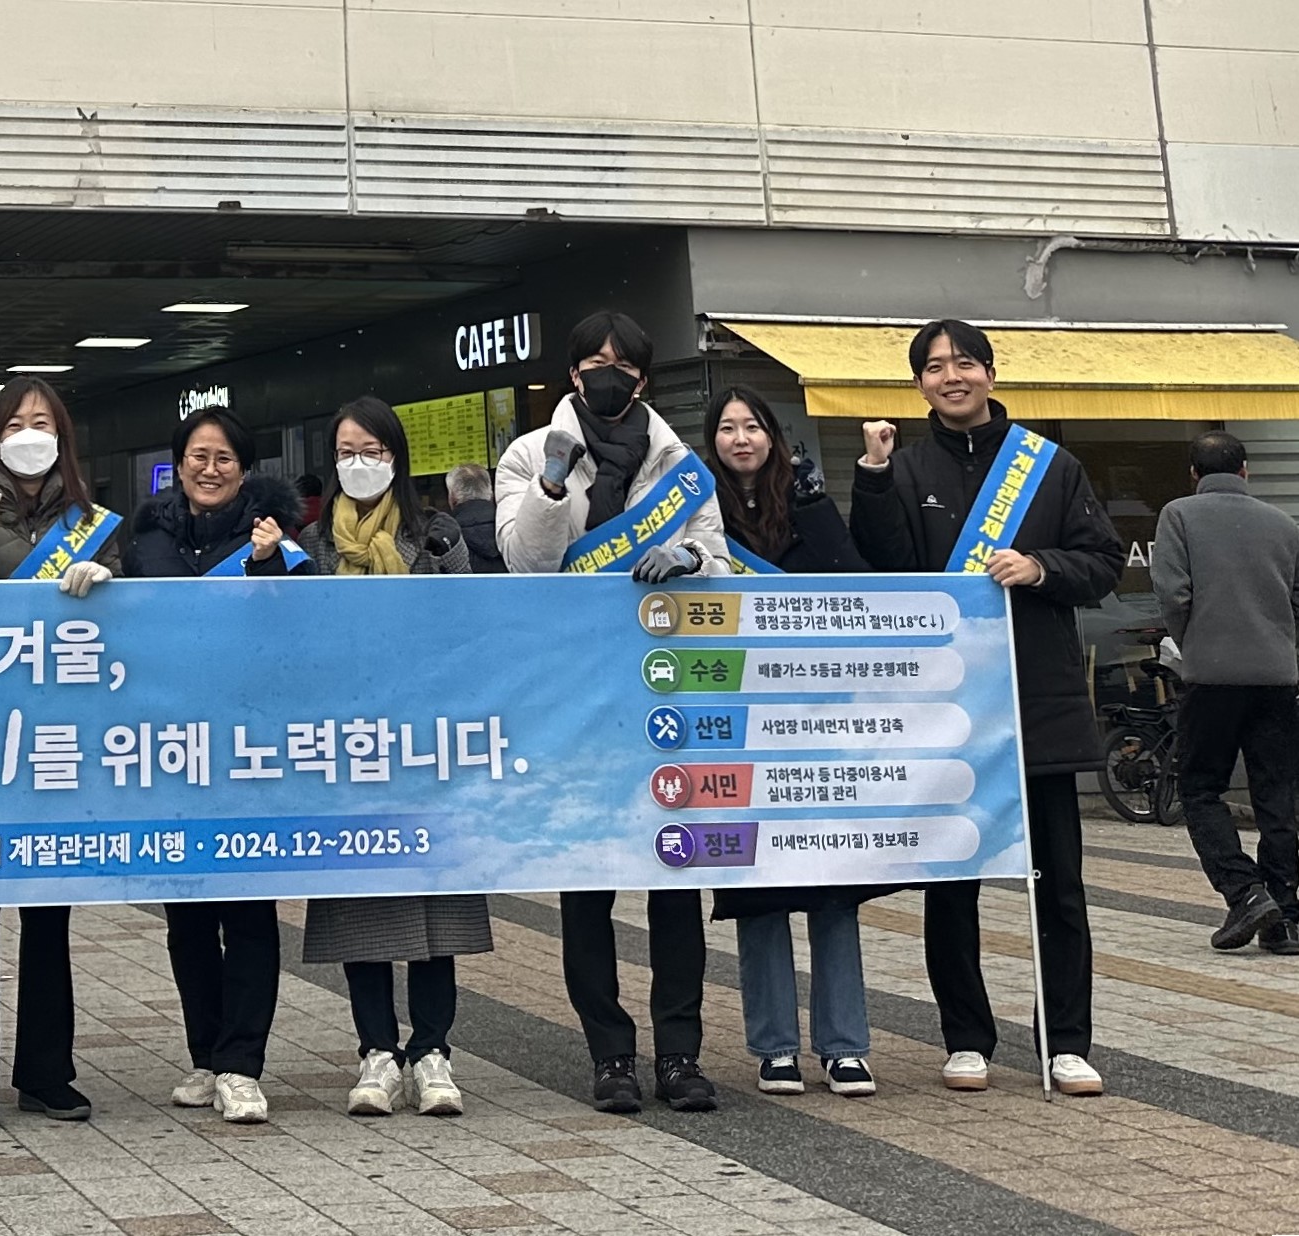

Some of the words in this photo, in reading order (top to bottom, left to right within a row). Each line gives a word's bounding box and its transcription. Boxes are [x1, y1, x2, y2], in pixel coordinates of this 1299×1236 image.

[455, 318, 507, 371] CAFE
[513, 313, 531, 361] U
[979, 451, 1036, 542] 계절관리제
[632, 485, 686, 544] 미세먼지
[687, 602, 726, 626] 공공
[753, 597, 814, 613] 공공사업장
[816, 597, 869, 613] 가동감축,
[755, 614, 828, 631] 행정공공기관
[830, 614, 867, 630] 에너지
[689, 659, 730, 683] 수송
[758, 662, 807, 678] 배출가스
[810, 662, 842, 677] 5등급
[845, 661, 869, 677] 차량
[872, 661, 920, 677] 운행제한
[695, 715, 733, 739] 산업
[762, 719, 798, 734] 사업장
[802, 719, 849, 734] 미세먼지
[852, 718, 876, 733] 발생
[879, 717, 904, 733] 감축
[101, 721, 211, 788] 위해
[229, 716, 529, 784] 노력합니다.
[700, 773, 738, 798] 시민
[766, 767, 815, 783] 지하역사
[818, 767, 831, 783] 등
[834, 766, 907, 782] 다중이용시설
[767, 786, 830, 802] 실내공기질
[832, 785, 857, 801] 관리
[8, 831, 132, 867] 계절관리제
[138, 831, 186, 864] 시행
[704, 833, 743, 857] 정보
[771, 833, 869, 850] 미세먼지(대기질)
[872, 832, 919, 848] 정보제공
